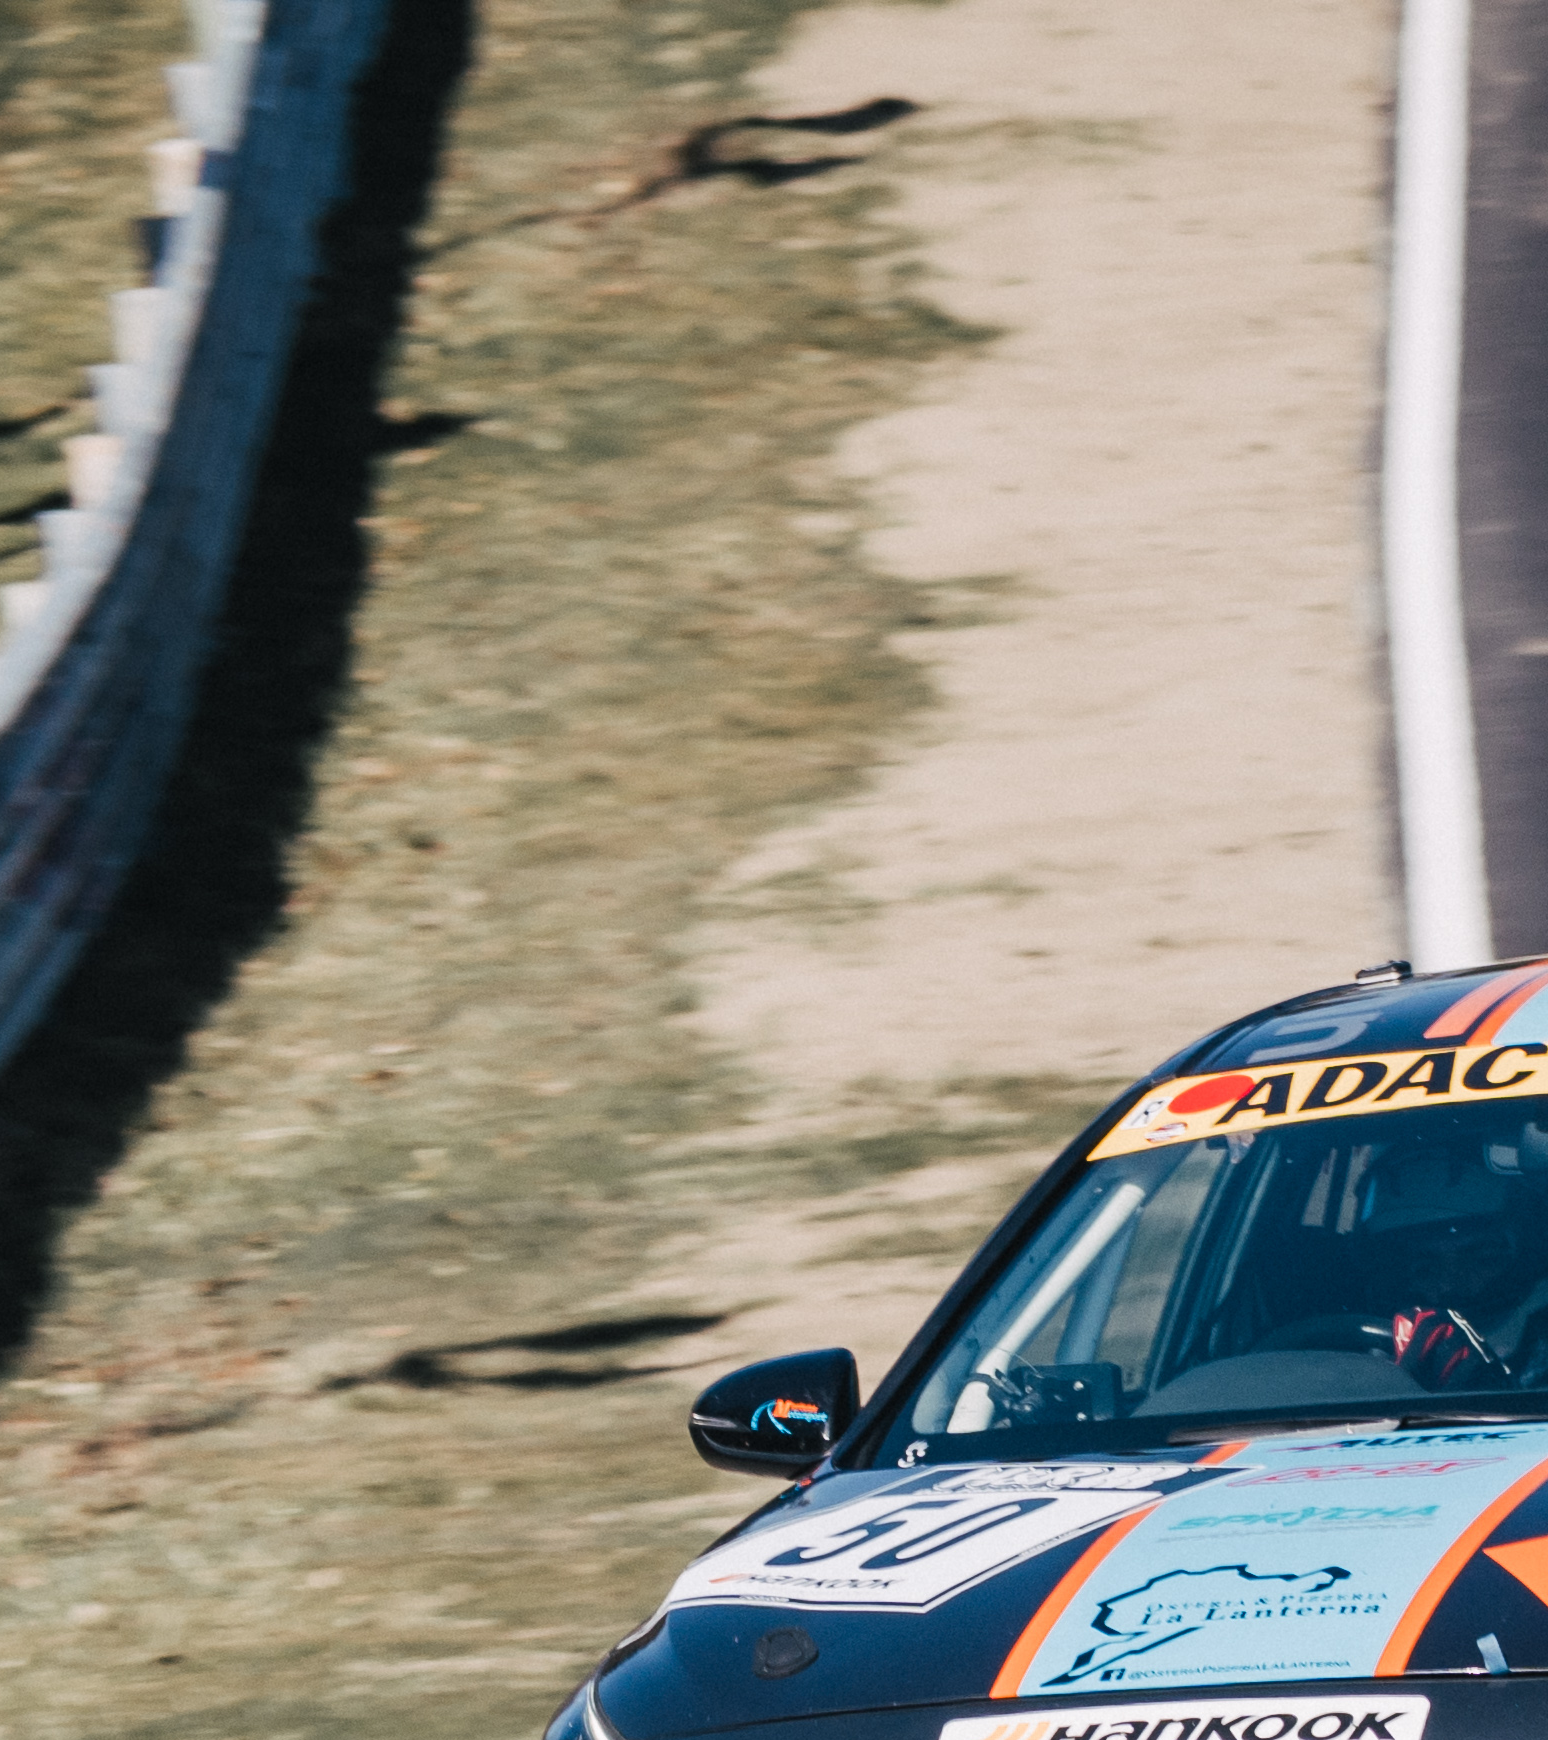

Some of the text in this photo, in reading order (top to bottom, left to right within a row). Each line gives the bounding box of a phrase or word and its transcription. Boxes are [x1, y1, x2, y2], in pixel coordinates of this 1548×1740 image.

[1214, 1043, 1548, 1126] ADAC
[763, 1497, 1058, 1570] 50
[1140, 1603, 1382, 1627] La Lanterna
